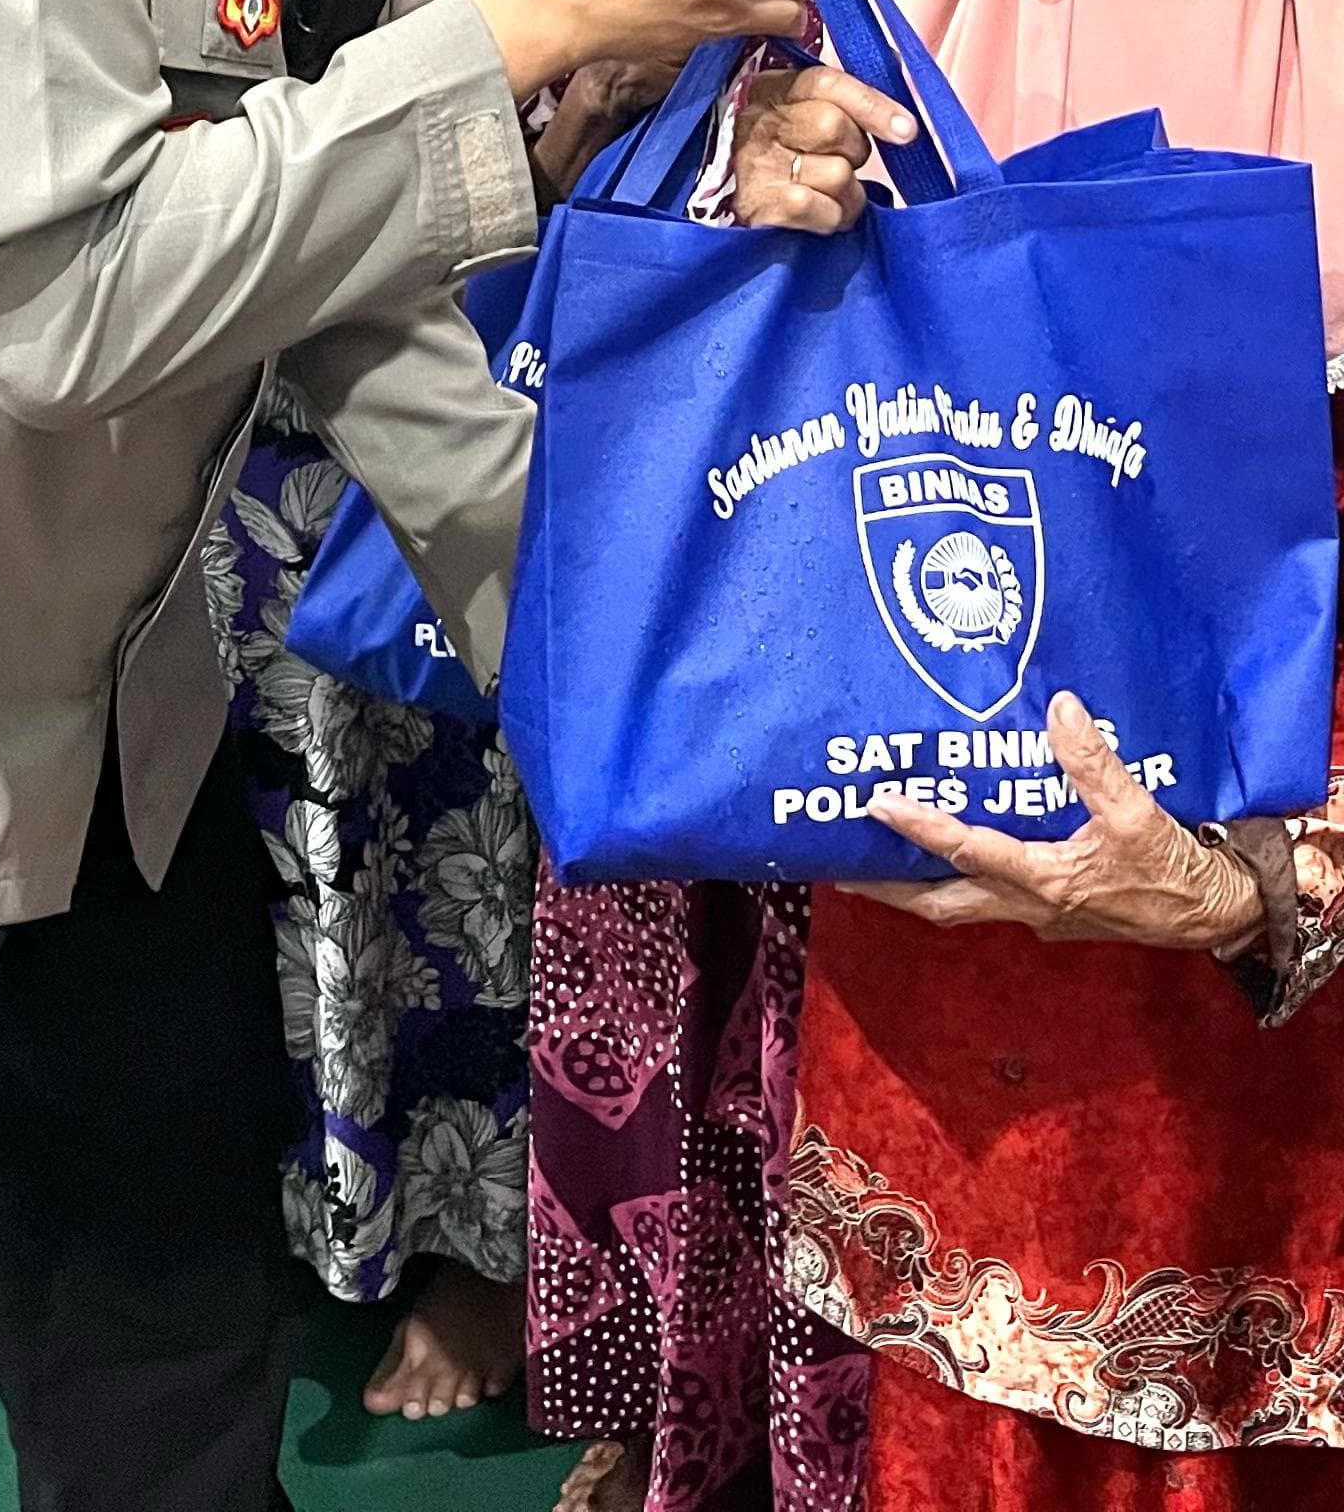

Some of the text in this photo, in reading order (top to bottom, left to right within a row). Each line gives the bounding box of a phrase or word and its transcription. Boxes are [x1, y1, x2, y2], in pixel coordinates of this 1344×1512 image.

[707, 412, 846, 520] Santunan
[844, 382, 940, 459] Yatim
[1011, 392, 1040, 450] &
[878, 468, 1011, 515] BINMAS
[826, 719, 1120, 775] SAT BINMS
[983, 753, 1177, 817] JEMR
